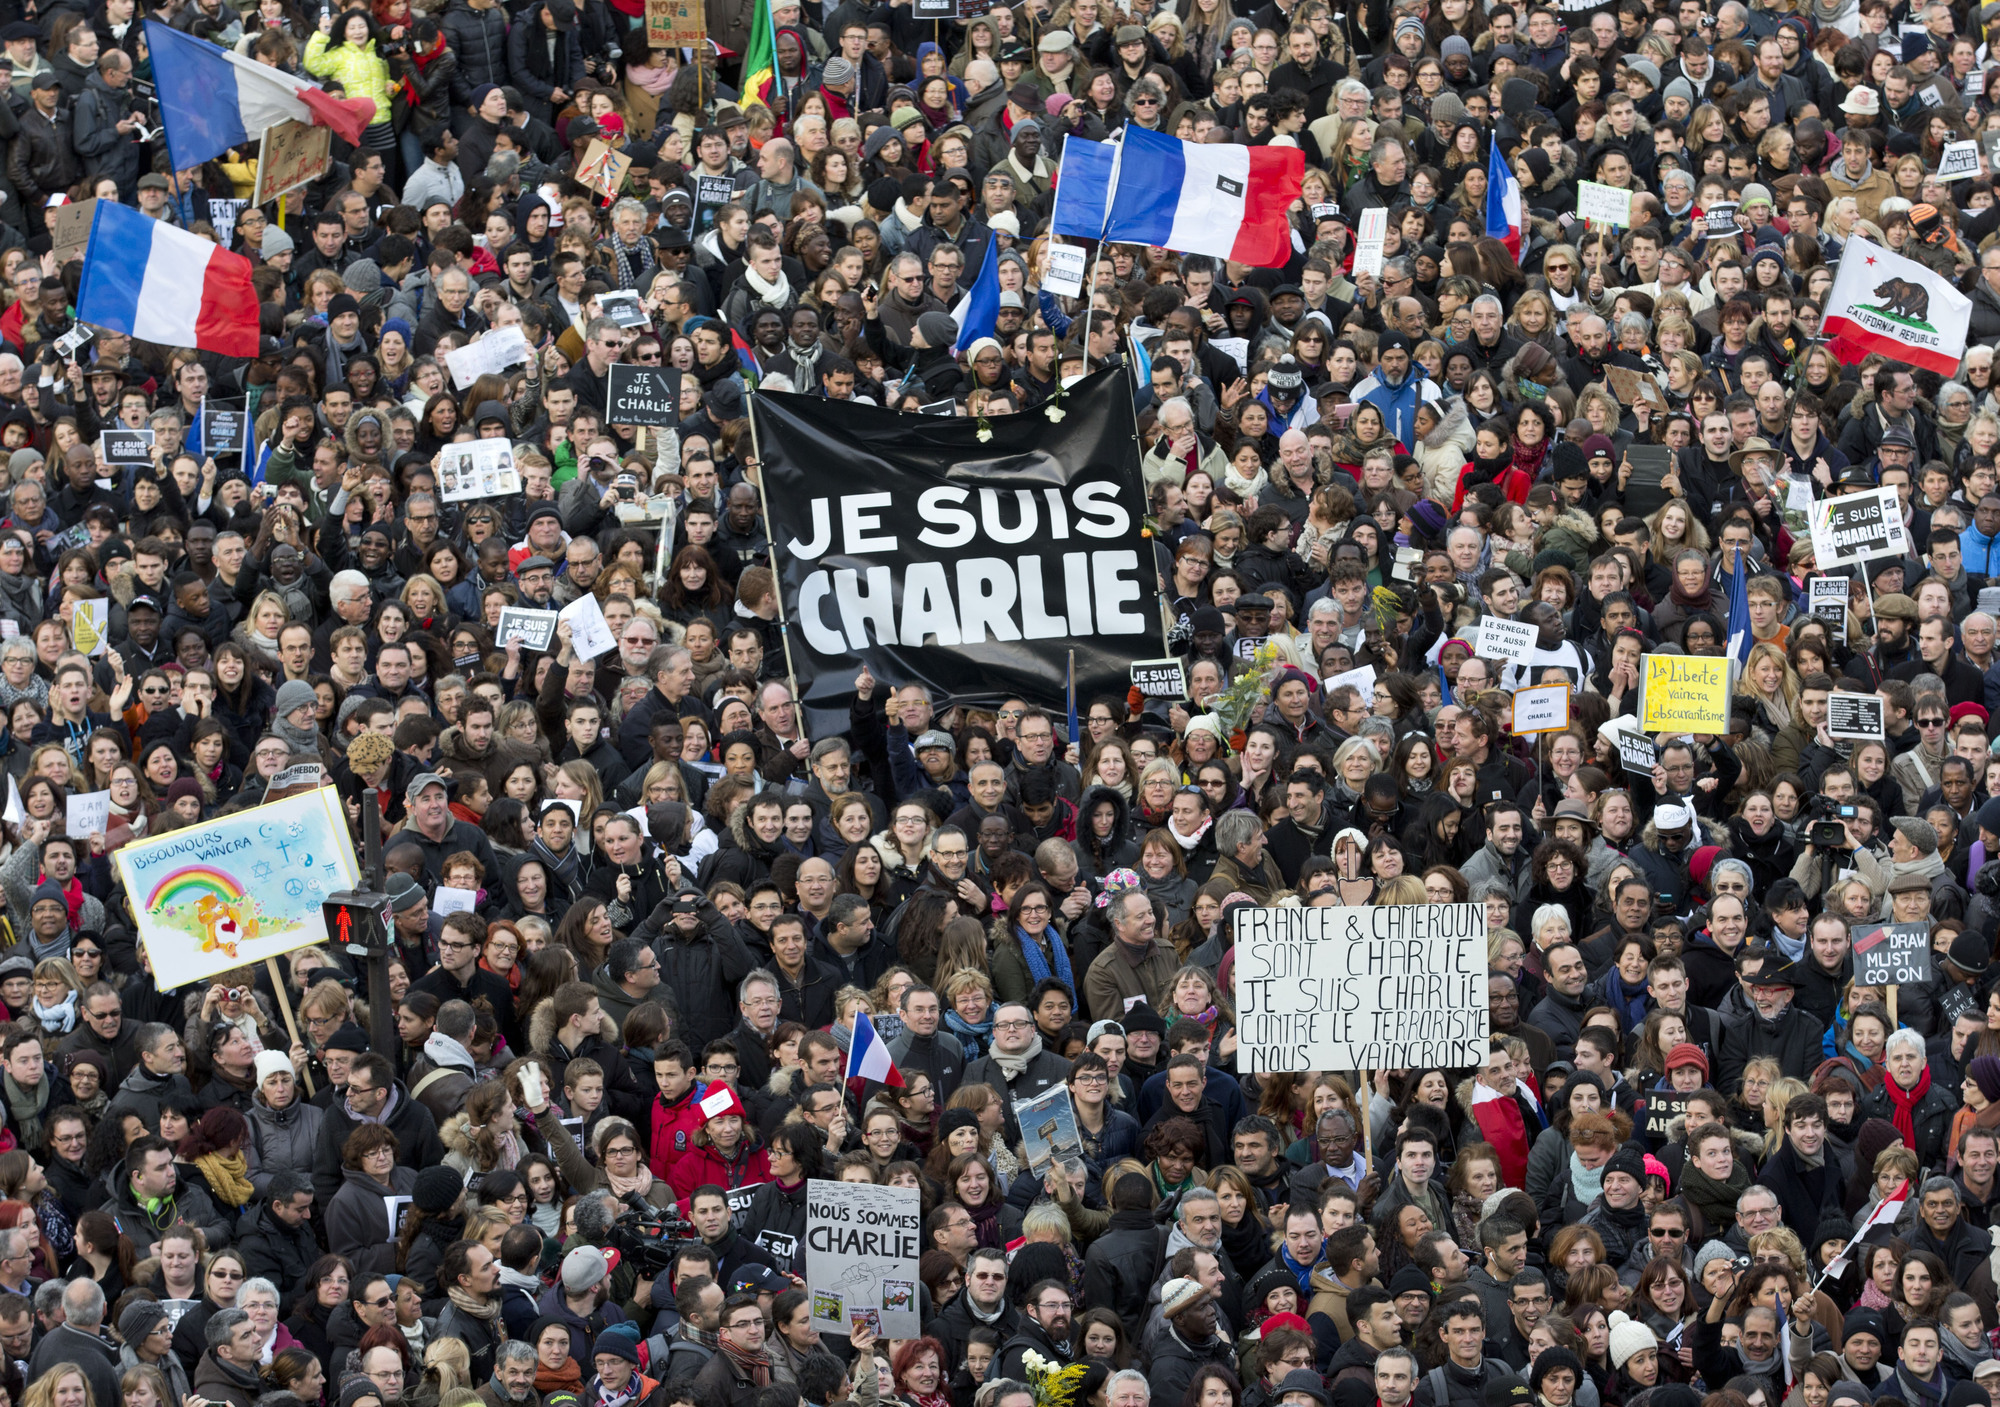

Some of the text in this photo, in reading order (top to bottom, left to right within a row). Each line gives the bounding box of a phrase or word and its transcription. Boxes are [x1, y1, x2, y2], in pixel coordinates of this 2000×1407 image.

[1948, 150, 1975, 161] SUIS
[1942, 160, 1978, 174] ARLIE
[701, 182, 731, 192] JE SUIS
[700, 191, 731, 204] CHARLIE
[1706, 210, 1733, 220] JE SUIS
[1051, 250, 1084, 263] JE SUIS
[1051, 266, 1082, 284] CHARLIE
[1846, 305, 1940, 347] CALIFORNIA REPUBLIC
[633, 373, 651, 384] JE
[1270, 372, 1300, 383] BROOKLYN
[111, 441, 147, 449] JE SUIS
[111, 448, 148, 457] CHARLIE
[786, 480, 1130, 561] JE SUIS
[1832, 507, 1880, 527] JE SUIS
[1833, 524, 1887, 548] CHARLIE
[1815, 587, 1846, 596] CHARLIE
[798, 549, 1145, 655] CHARLIE
[506, 618, 549, 631] JE SUIS
[1485, 620, 1531, 637] LE SENEGAL
[1485, 632, 1527, 647] EST AUSSI
[1487, 645, 1521, 658] CHARLIE
[1134, 669, 1181, 684] JE SUIS
[1653, 659, 1721, 687] La Liberté
[1530, 698, 1551, 706] MERCI
[1528, 712, 1553, 721] CHARLIE
[1620, 735, 1654, 755] JE SUIS
[294, 766, 320, 776] HEBDO
[1237, 904, 1485, 942] FRANCE & CAMEROUN
[1890, 932, 1928, 949] DRAW
[1251, 943, 1317, 979] SONT
[1867, 951, 1912, 968] MUST
[1865, 966, 1923, 984] GO ON
[1241, 979, 1277, 1014] JE
[1942, 989, 1966, 1010] I AM
[1241, 1012, 1320, 1045] CONTRE
[1333, 1012, 1355, 1043] LE
[1251, 1044, 1311, 1072] NOUS
[1649, 1096, 1688, 1112] Je su
[728, 1194, 752, 1212] SU
[809, 1202, 920, 1230] NOUS SOMMES
[771, 1240, 792, 1257] SU
